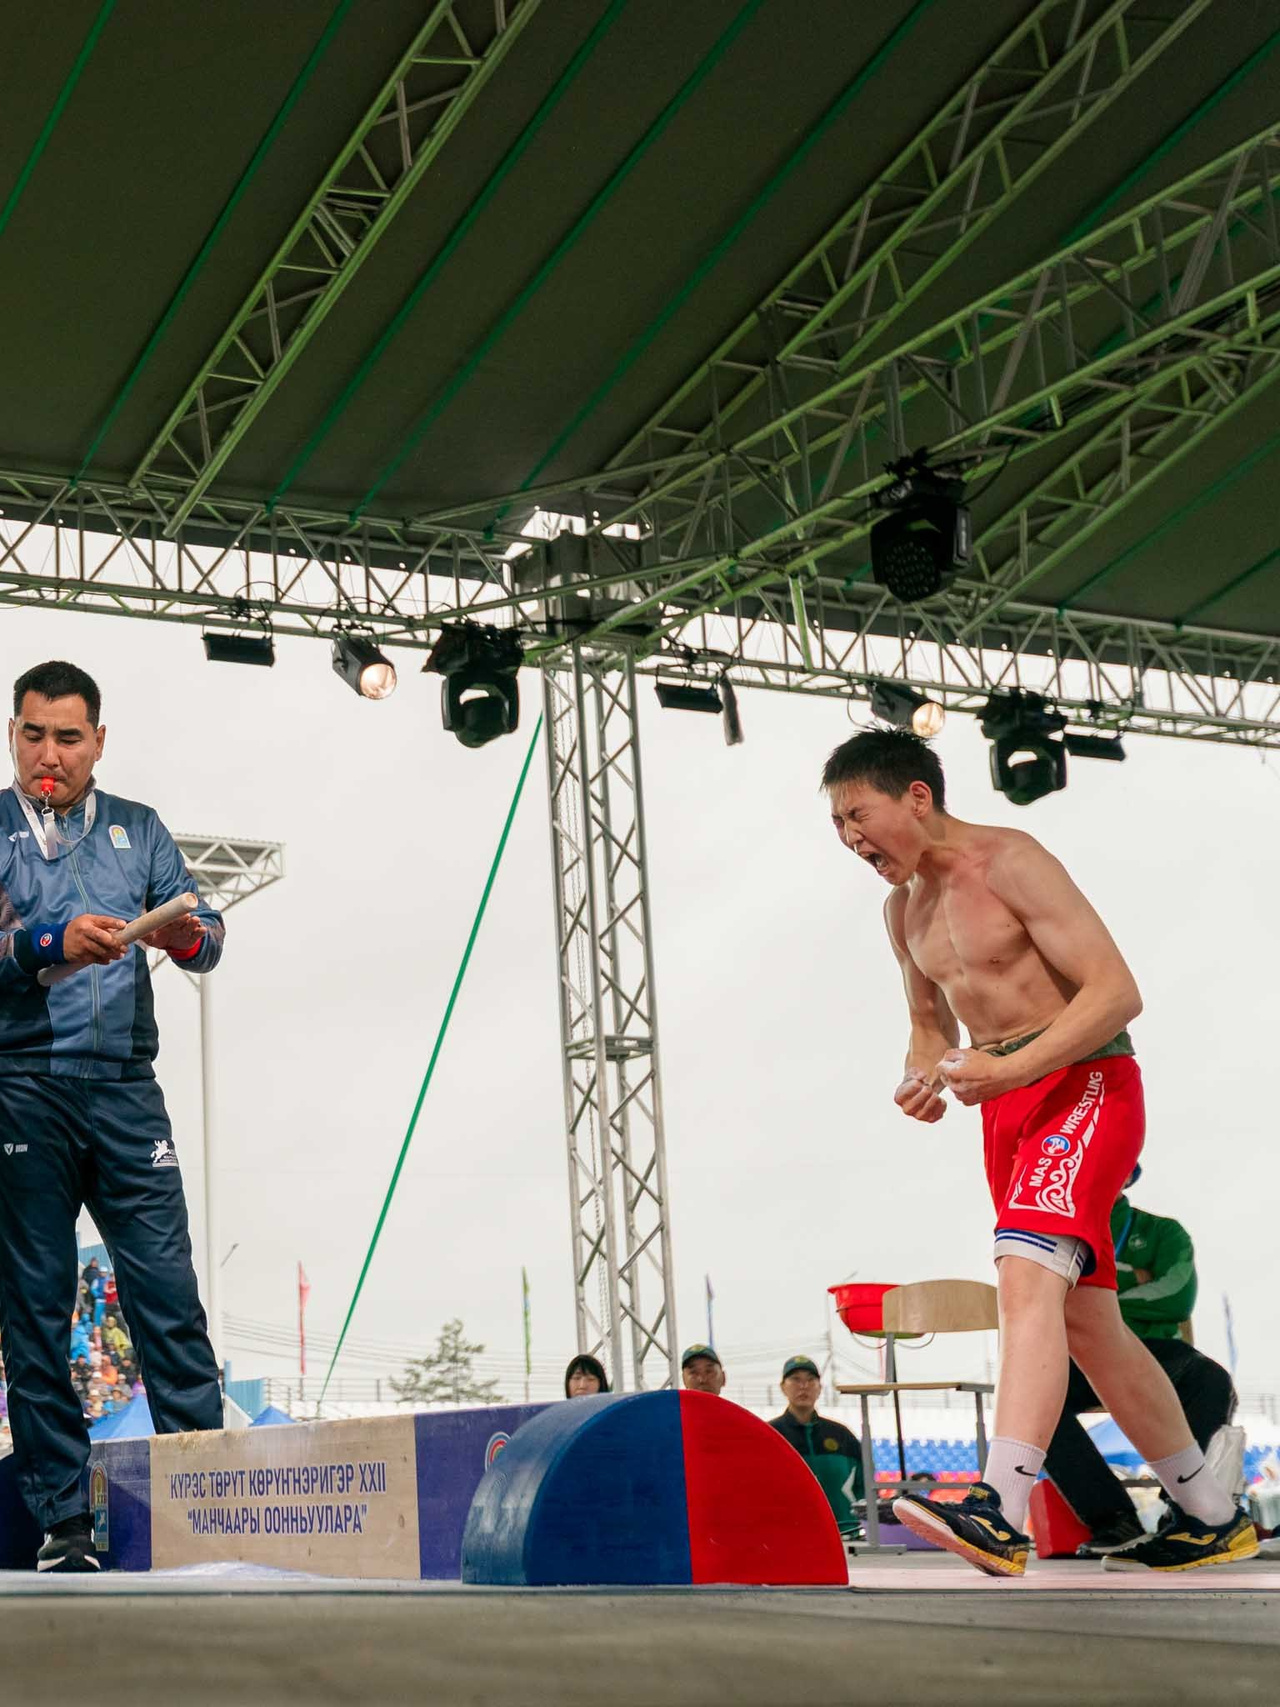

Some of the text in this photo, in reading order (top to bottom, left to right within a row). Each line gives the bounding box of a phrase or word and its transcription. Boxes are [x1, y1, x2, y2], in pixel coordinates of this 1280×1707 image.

[1029, 1071, 1103, 1188] MAS WRESTLING
[170, 1474, 206, 1499] КҮРЭС
[209, 1470, 246, 1498] ТӨРҮТ
[358, 1462, 386, 1493] XXII
